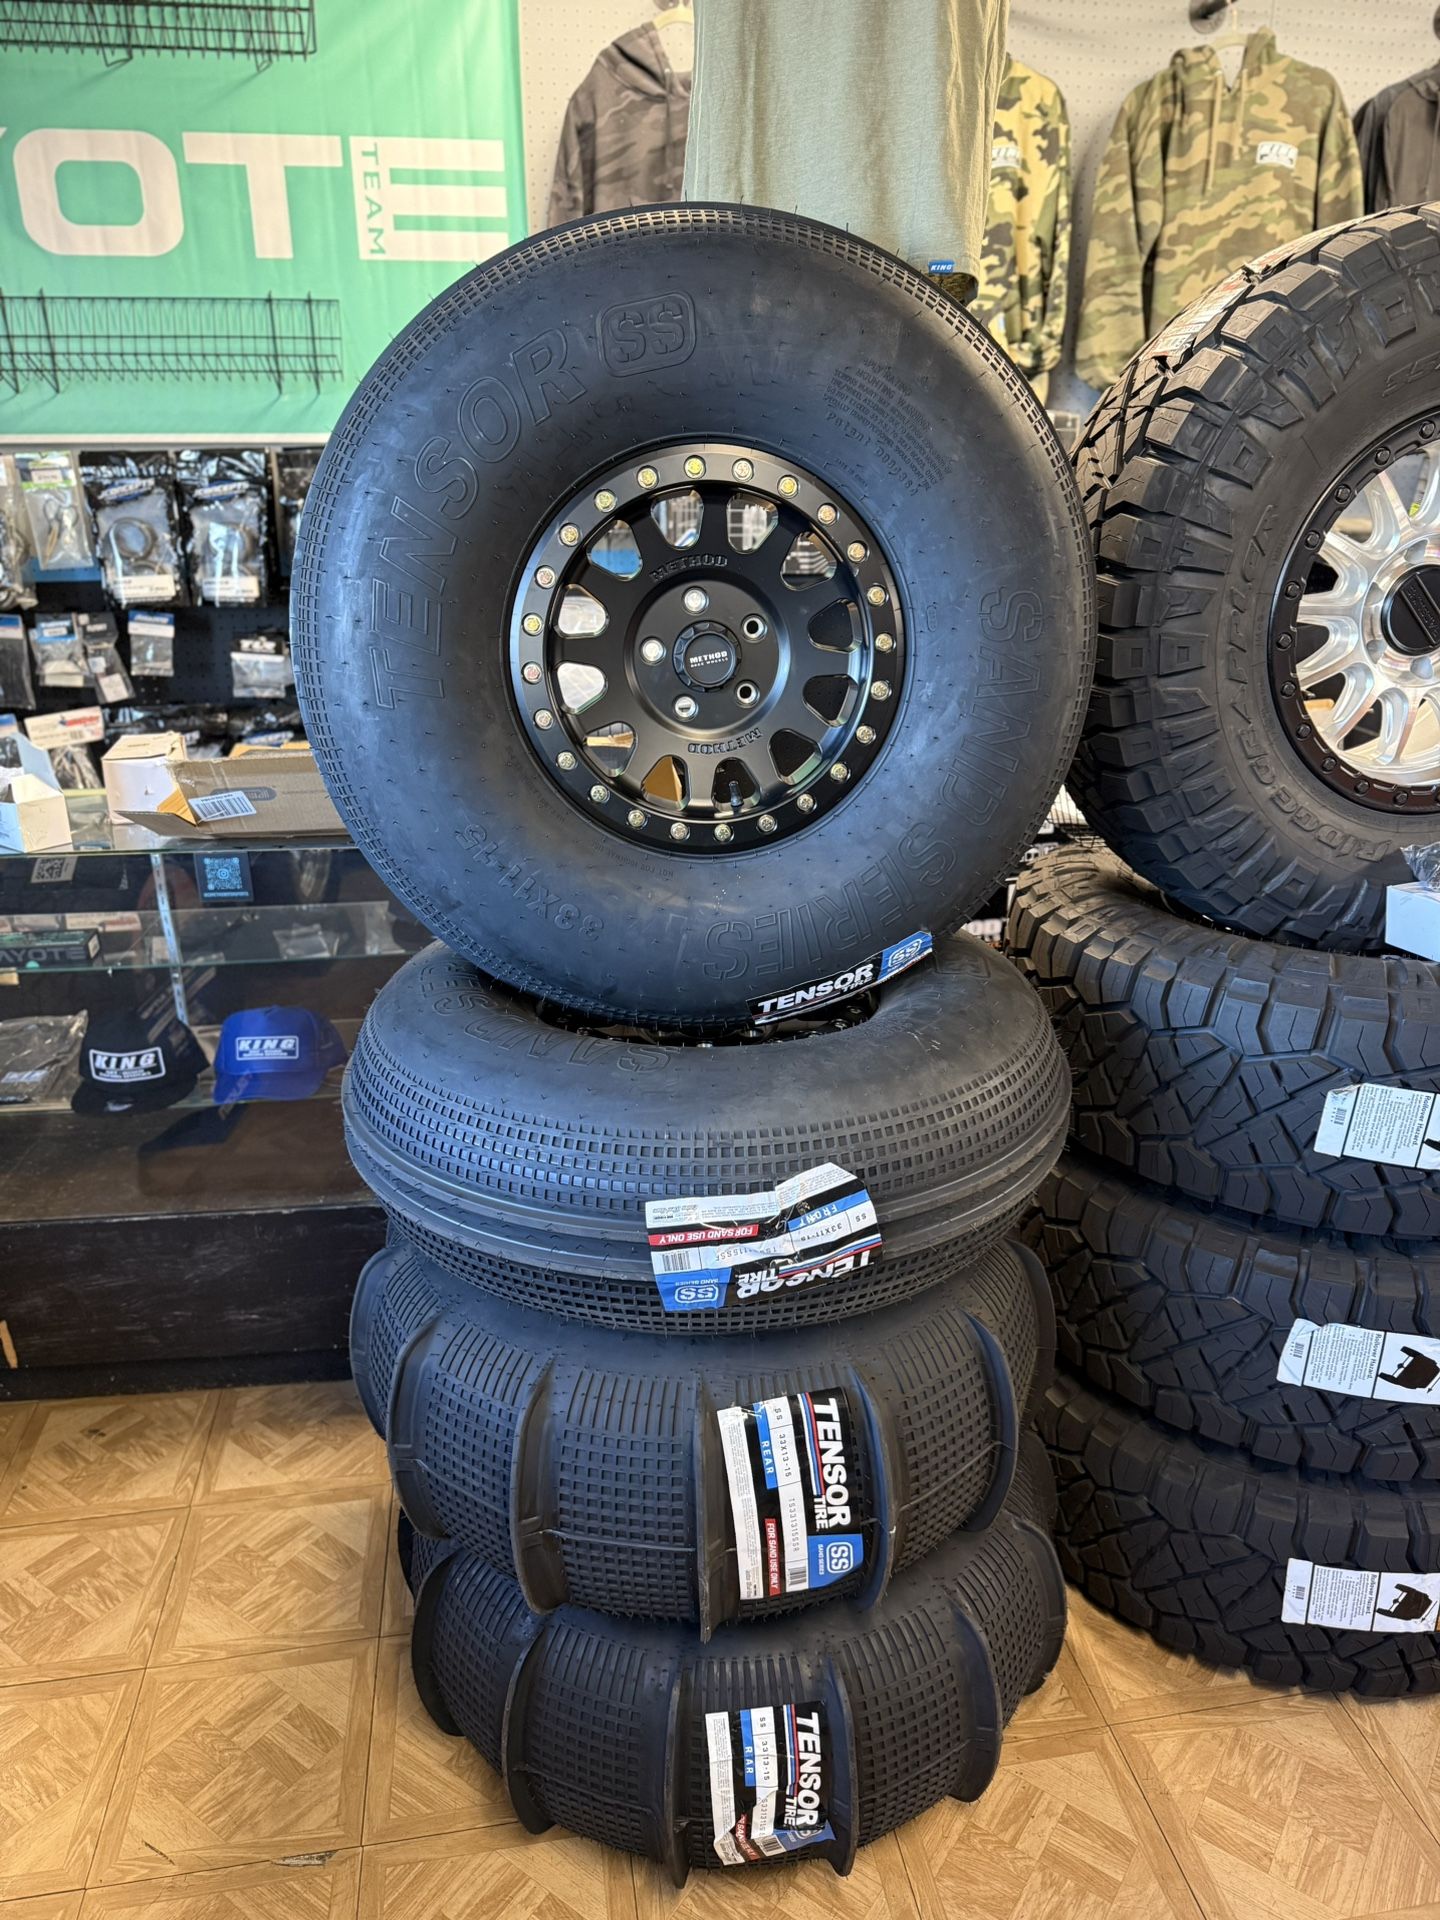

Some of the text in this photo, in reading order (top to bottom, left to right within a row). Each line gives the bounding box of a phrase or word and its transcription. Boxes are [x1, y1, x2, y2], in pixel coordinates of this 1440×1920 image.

[0, 127, 508, 261] OTE
[360, 143, 388, 256] TEAM
[367, 328, 588, 712] TENSOR
[608, 300, 686, 363] SS
[648, 553, 729, 583] METHOD
[689, 650, 728, 664] METHOD
[939, 588, 1045, 826] SAND
[687, 728, 764, 755] METHOD
[1268, 786, 1393, 863] RIDGE
[455, 823, 606, 942] 33X11-15
[704, 821, 958, 980] SERIES
[757, 962, 875, 1015] TENSOR
[841, 974, 874, 993] TIRE
[94, 1053, 157, 1070] KING
[238, 1038, 297, 1050] KING
[1420, 1095, 1432, 1124] Rollover
[658, 1225, 753, 1244] FOR SAND USE ONLY
[855, 1212, 868, 1223] SS
[736, 1268, 782, 1287] TIRE
[737, 1250, 874, 1299] TENSOR
[679, 1287, 715, 1301] SS
[761, 1441, 775, 1475] REAR
[778, 1433, 791, 1478] 33X13-15
[813, 1397, 852, 1571] TENSOR SS
[813, 1495, 831, 1531] TIRE
[766, 1523, 779, 1590] FOR SAND USE ONLY
[759, 1717, 767, 1728] SS
[744, 1746, 754, 1774] RAR
[760, 1741, 771, 1781] 3313-15
[794, 1711, 822, 1827] TENSOR
[783, 1796, 798, 1828] TIRE
